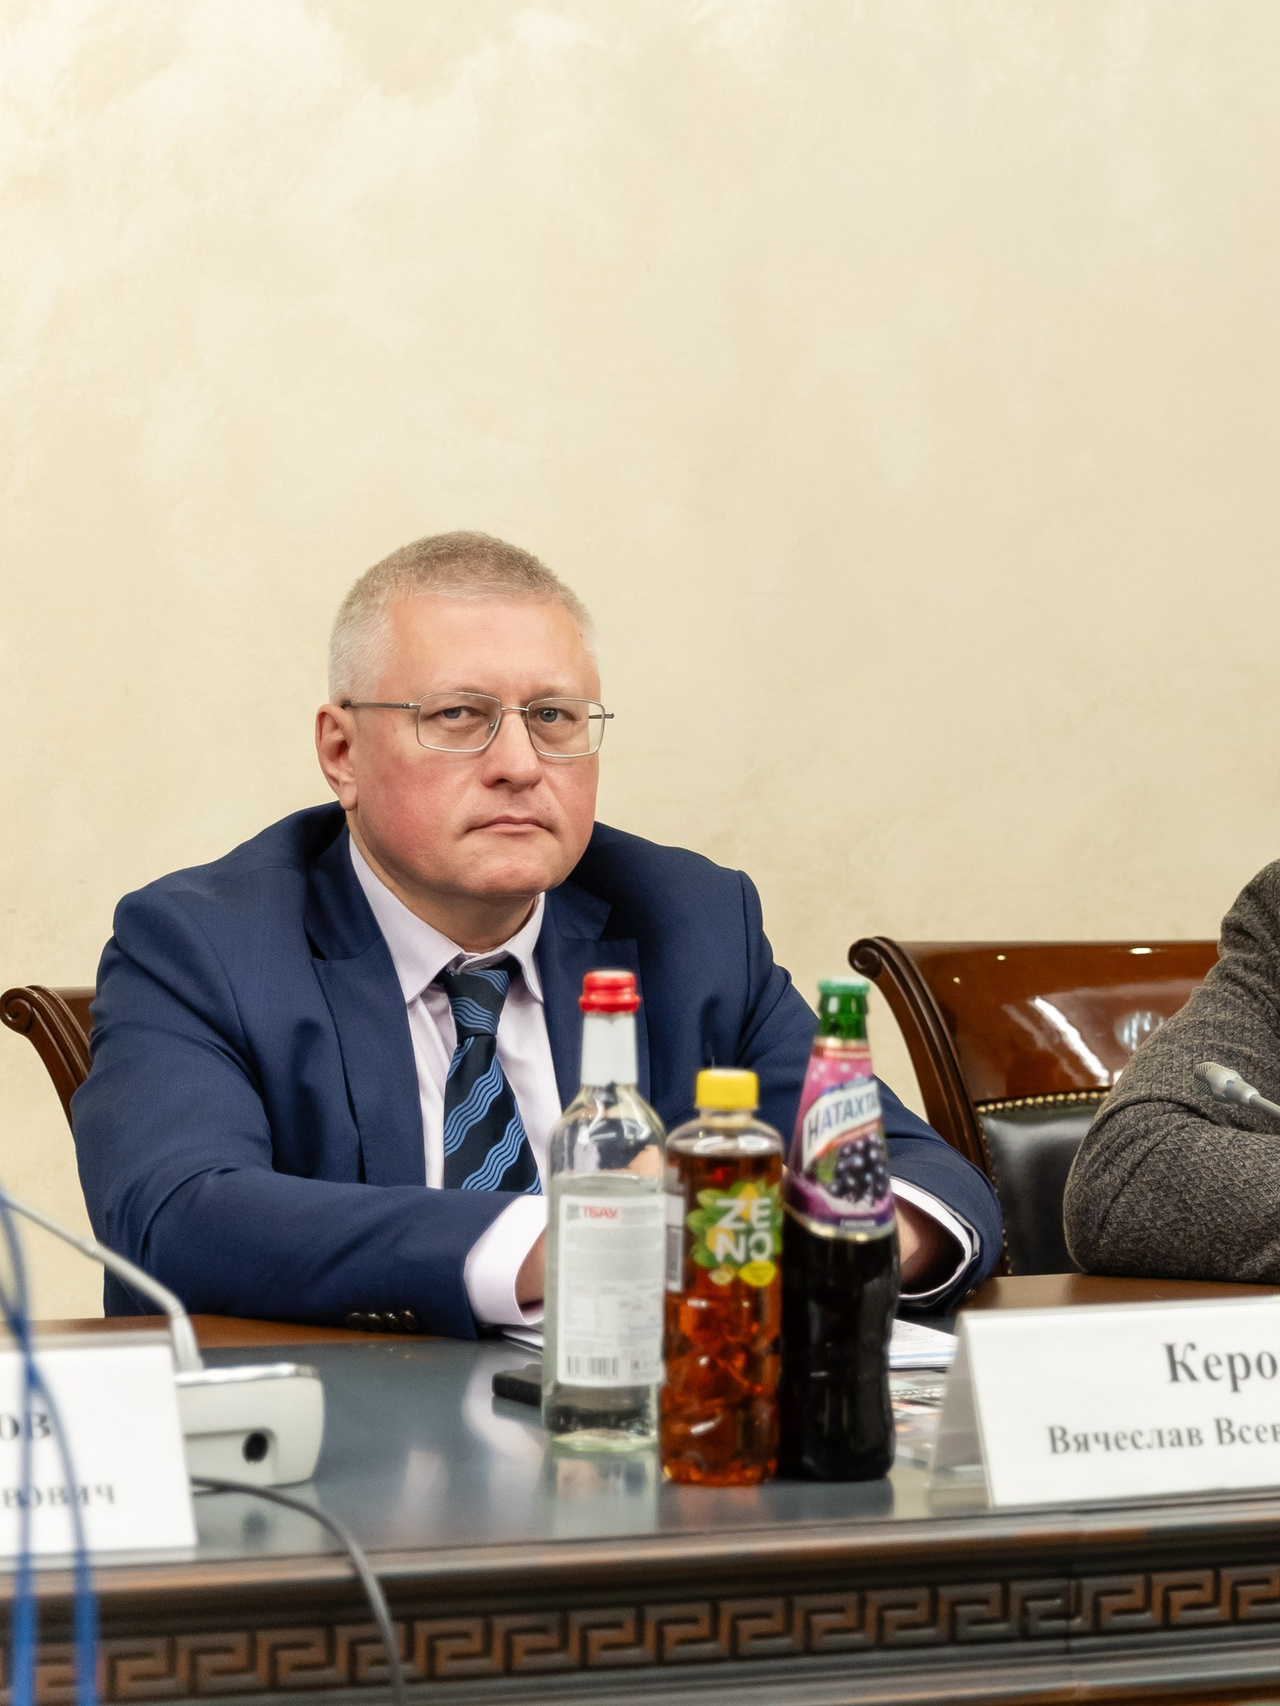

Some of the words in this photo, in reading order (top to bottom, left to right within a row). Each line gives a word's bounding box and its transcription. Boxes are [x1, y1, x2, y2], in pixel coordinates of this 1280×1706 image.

[716, 1198, 771, 1230] ZE
[715, 1231, 773, 1263] NO
[1047, 1425, 1204, 1455] Вячеслав
